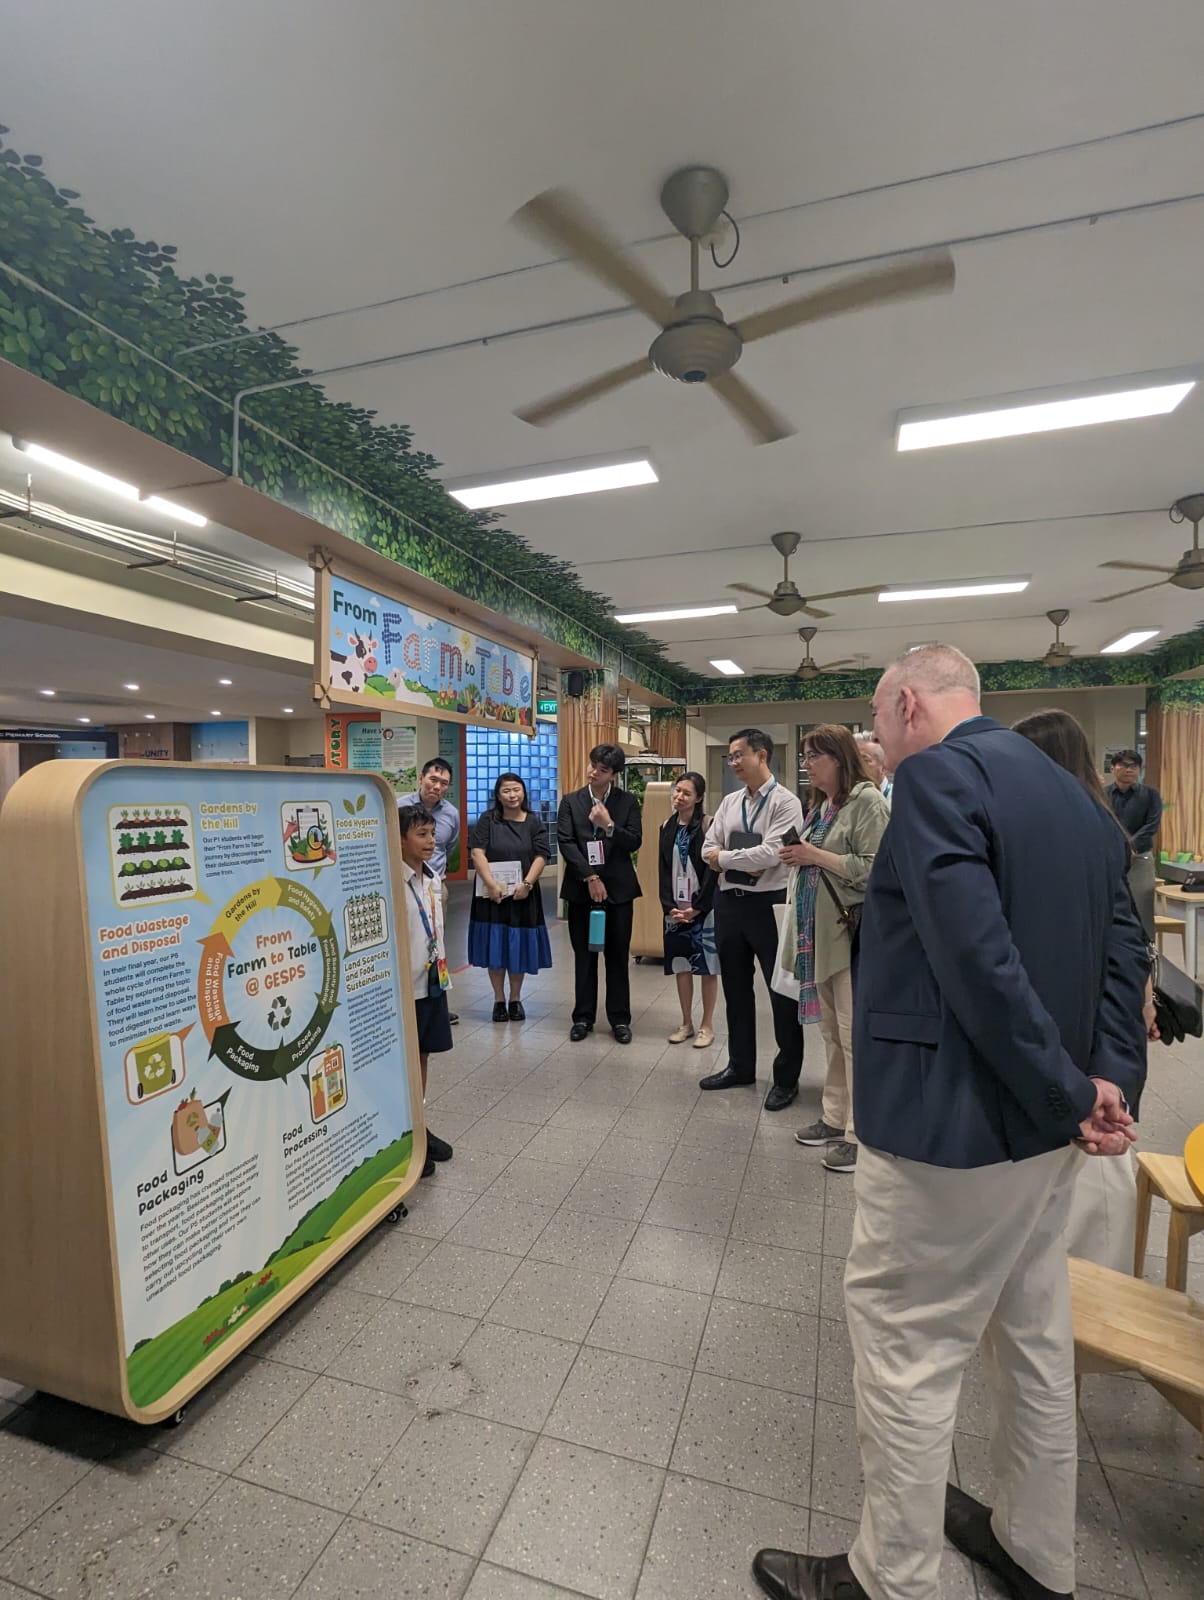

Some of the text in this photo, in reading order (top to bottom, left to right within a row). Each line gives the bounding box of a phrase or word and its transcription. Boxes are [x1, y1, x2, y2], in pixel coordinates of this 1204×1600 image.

[332, 590, 530, 704] From Farm to Table
[544, 703, 558, 712] EXIT
[200, 802, 256, 815] Gardens by
[202, 817, 238, 830] the Hill
[352, 831, 374, 839] Safety
[354, 819, 378, 828] Hygiene
[226, 892, 251, 918] Gardens
[235, 899, 256, 922] the Hill
[100, 915, 189, 941] Food Wastage
[256, 930, 292, 948] From
[102, 933, 180, 960] and Disposal
[112, 966, 126, 974] their
[128, 961, 142, 970] final
[143, 959, 158, 968] year,
[227, 942, 317, 978] Farm to Table
[345, 950, 390, 972] Land Scarcity
[104, 974, 133, 986] students
[147, 964, 174, 975] complete
[246, 964, 306, 997] @ GESPS
[346, 971, 391, 992] Sustainability
[105, 987, 125, 996] whole
[126, 982, 143, 990] cycle
[106, 997, 124, 1006] Table
[135, 986, 164, 998] exploring
[115, 1004, 130, 1014] food
[132, 1000, 150, 1008] waste
[152, 994, 163, 1003] and
[164, 986, 189, 999] disposal
[107, 1018, 124, 1026] They
[126, 1012, 136, 1021] will
[138, 1008, 153, 1016] learn
[108, 1027, 124, 1037] food
[125, 1018, 151, 1031] digester
[153, 1013, 164, 1022] and
[166, 1009, 181, 1018] learn
[148, 1024, 162, 1033] food
[292, 1026, 321, 1061] Processing
[297, 1030, 311, 1048] Food
[226, 1047, 260, 1073] Packaging
[237, 1045, 254, 1060] Food
[282, 1124, 303, 1144] Food
[284, 1124, 328, 1158] Processing
[137, 1170, 168, 1197] Food
[139, 1169, 204, 1216] Packaging
[140, 1216, 157, 1232] Food
[158, 1198, 189, 1221] packaging
[190, 1190, 200, 1200] has
[141, 1229, 155, 1242] over
[157, 1222, 166, 1231] the
[168, 1211, 184, 1225] years.
[187, 1195, 209, 1212] Besides
[143, 1247, 159, 1262] other
[161, 1237, 176, 1250] uses.
[178, 1227, 189, 1237] Our
[190, 1220, 198, 1229] P5
[150, 1224, 179, 1246] transport,
[182, 1213, 194, 1225] food
[144, 1259, 157, 1272] how
[158, 1249, 171, 1261] they
[173, 1241, 184, 1251] can
[185, 1230, 200, 1243] make
[144, 1248, 188, 1282] selecting food
[146, 1277, 162, 1292] carry
[164, 1267, 173, 1278] out
[175, 1248, 202, 1270] upcycling
[146, 1244, 222, 1302] unwanted food packaging.
